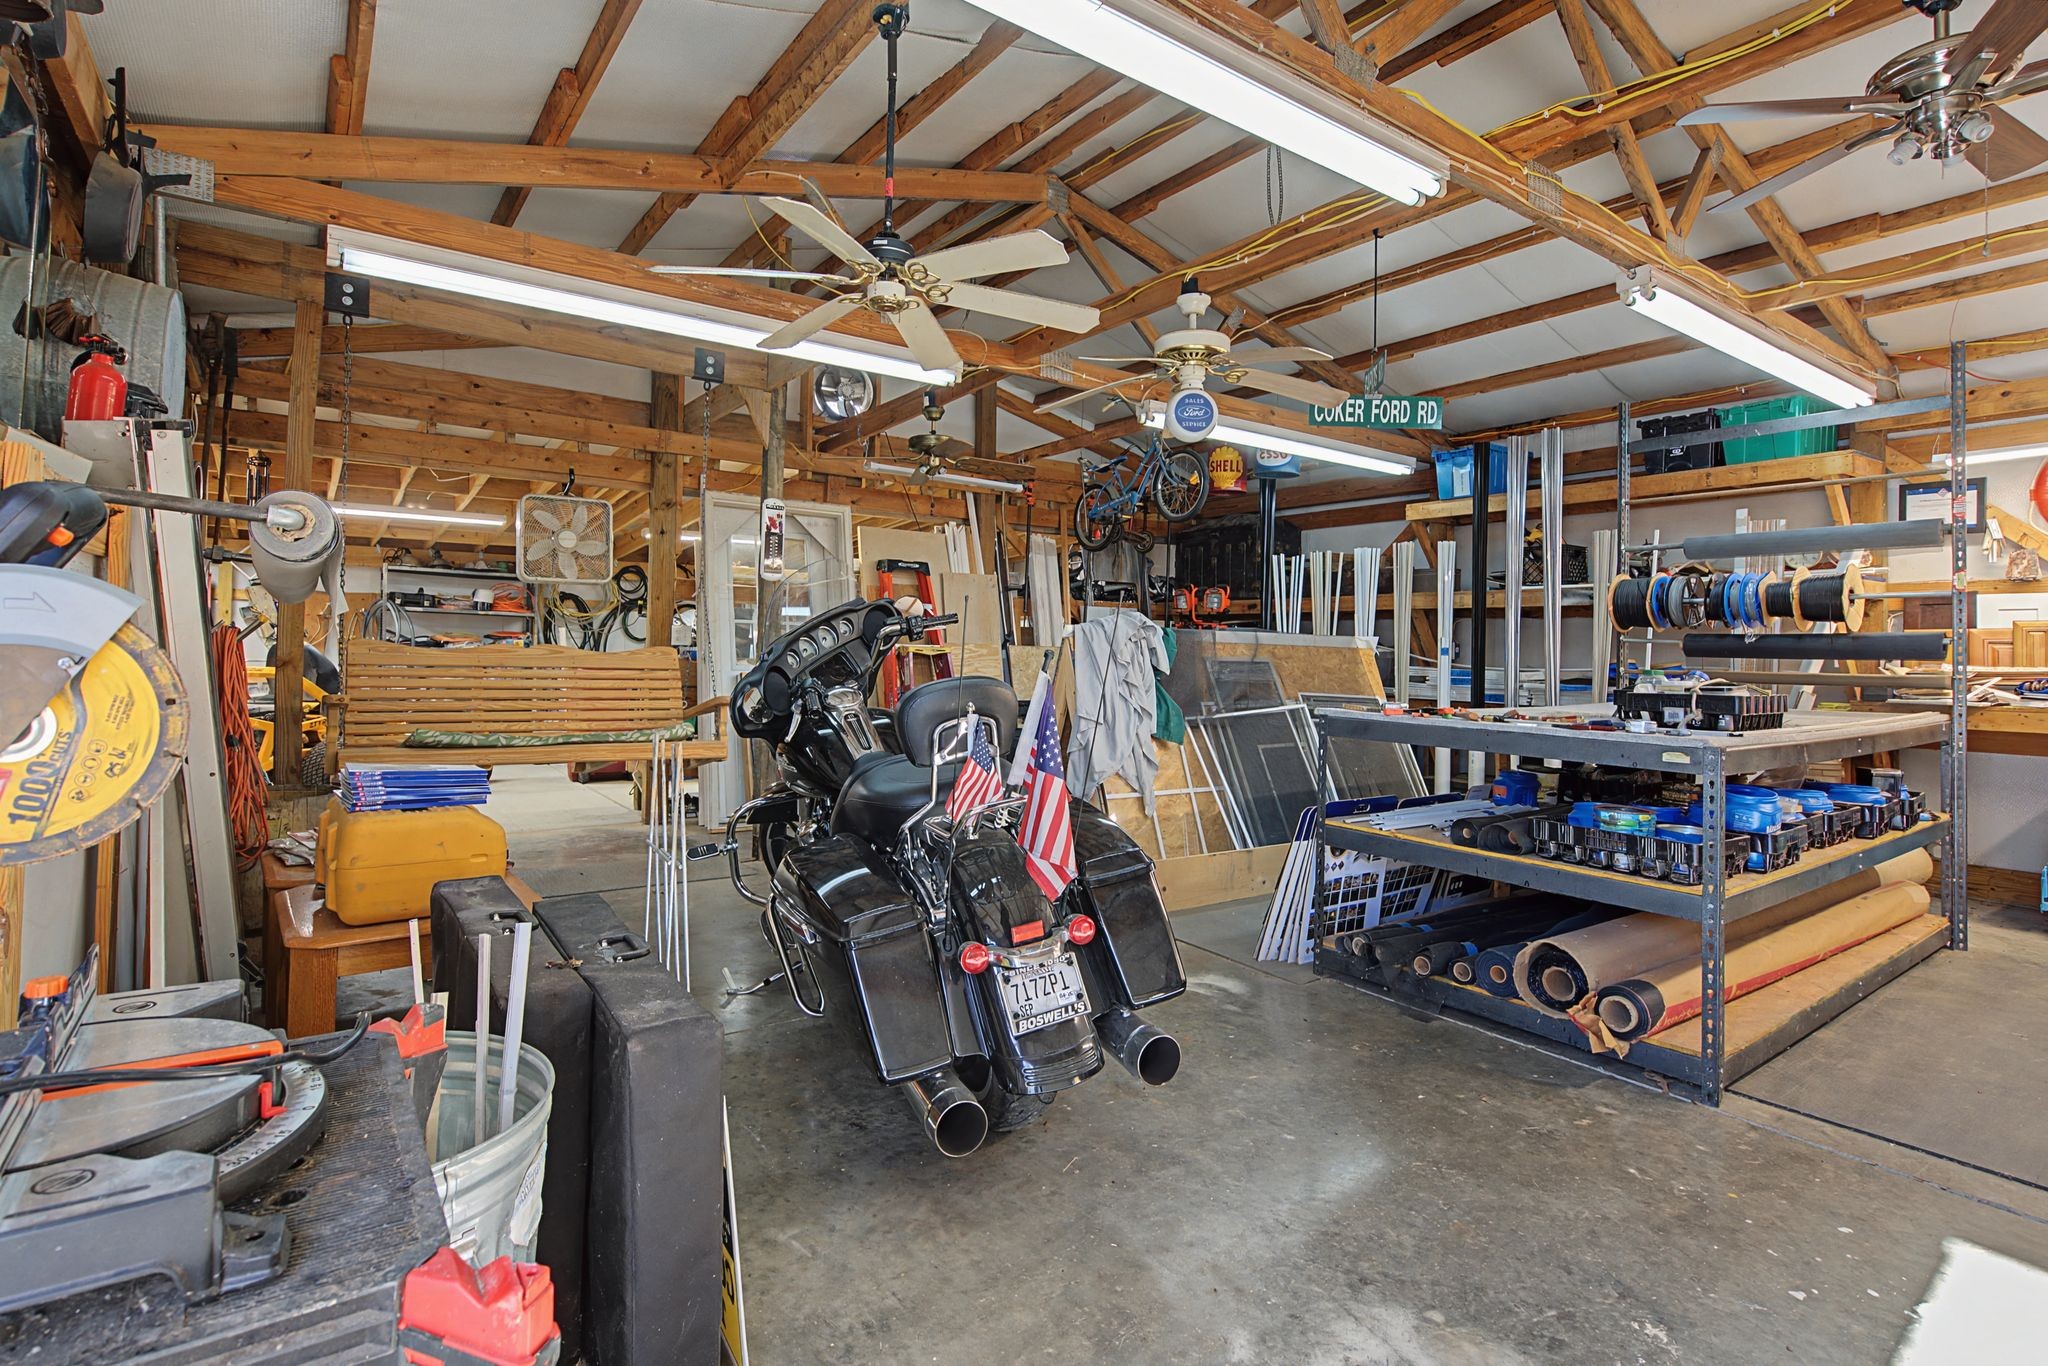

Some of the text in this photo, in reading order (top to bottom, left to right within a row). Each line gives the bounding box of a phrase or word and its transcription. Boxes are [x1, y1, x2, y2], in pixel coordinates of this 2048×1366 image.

[1183, 407, 1206, 417] Ford
[1314, 399, 1438, 424] COKER FORD RD
[1210, 459, 1241, 472] SHELL
[1011, 971, 1070, 1005] 717ZP1
[1018, 1002, 1085, 1033] BOSWELL'S
[1019, 1003, 1034, 1018] SEP
